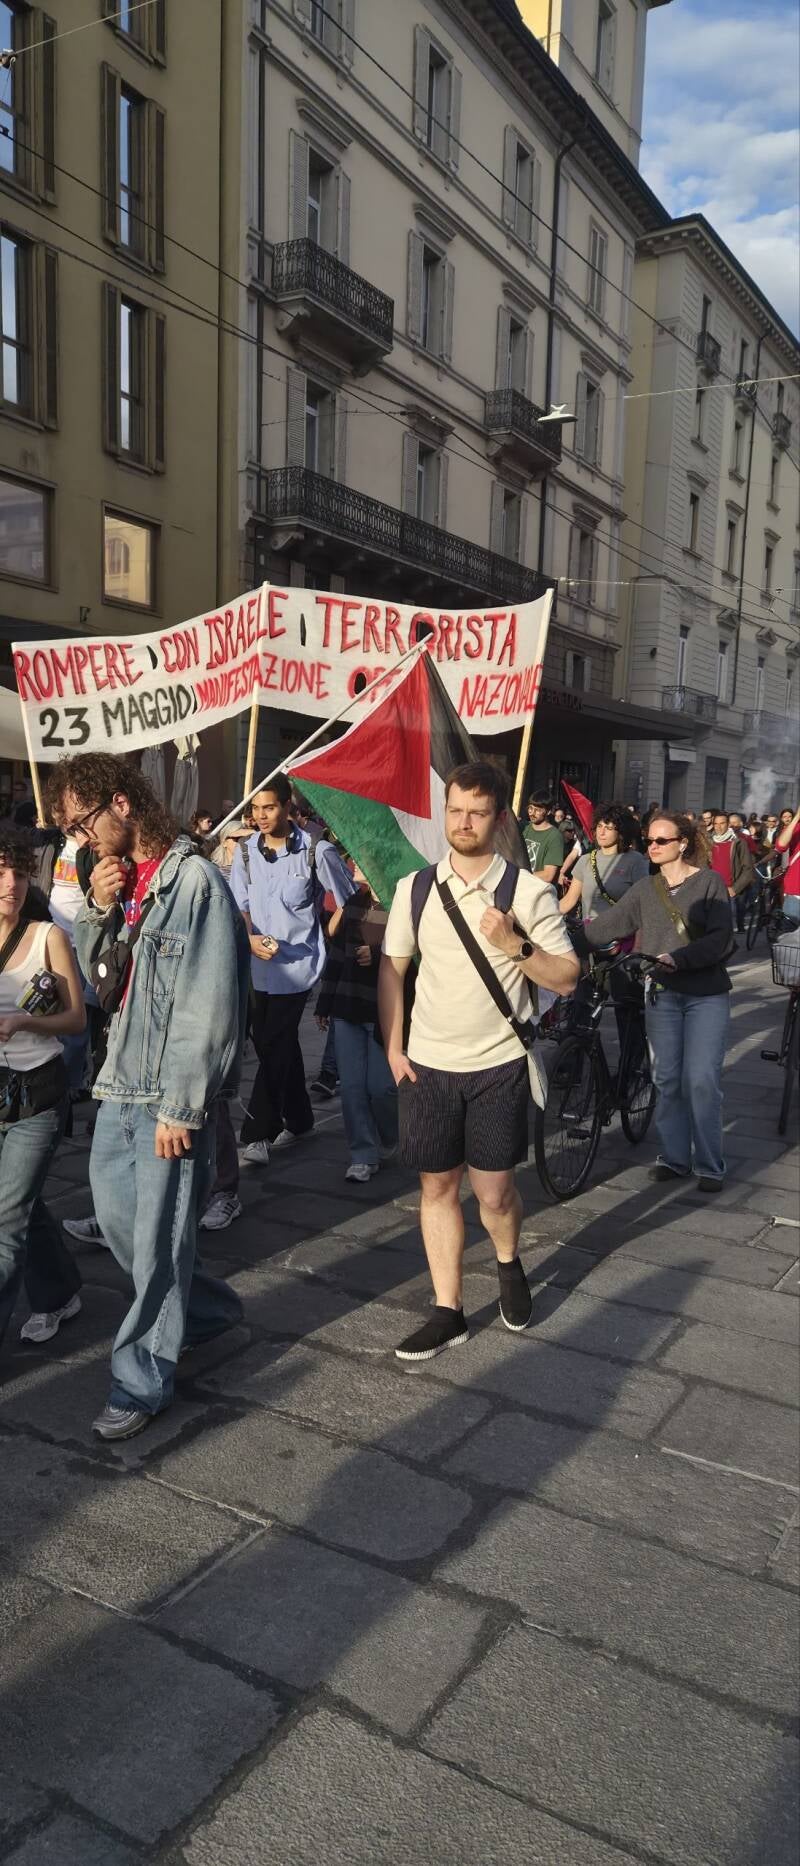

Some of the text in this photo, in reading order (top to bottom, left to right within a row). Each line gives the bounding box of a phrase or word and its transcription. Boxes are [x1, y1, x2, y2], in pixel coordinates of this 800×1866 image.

[14, 590, 517, 702] ROMPERE CON ISRAELE TERRORISTA
[39, 707, 90, 748] 23
[101, 684, 194, 738] MAGGIO
[195, 652, 331, 713] MANIFESTAZIONE
